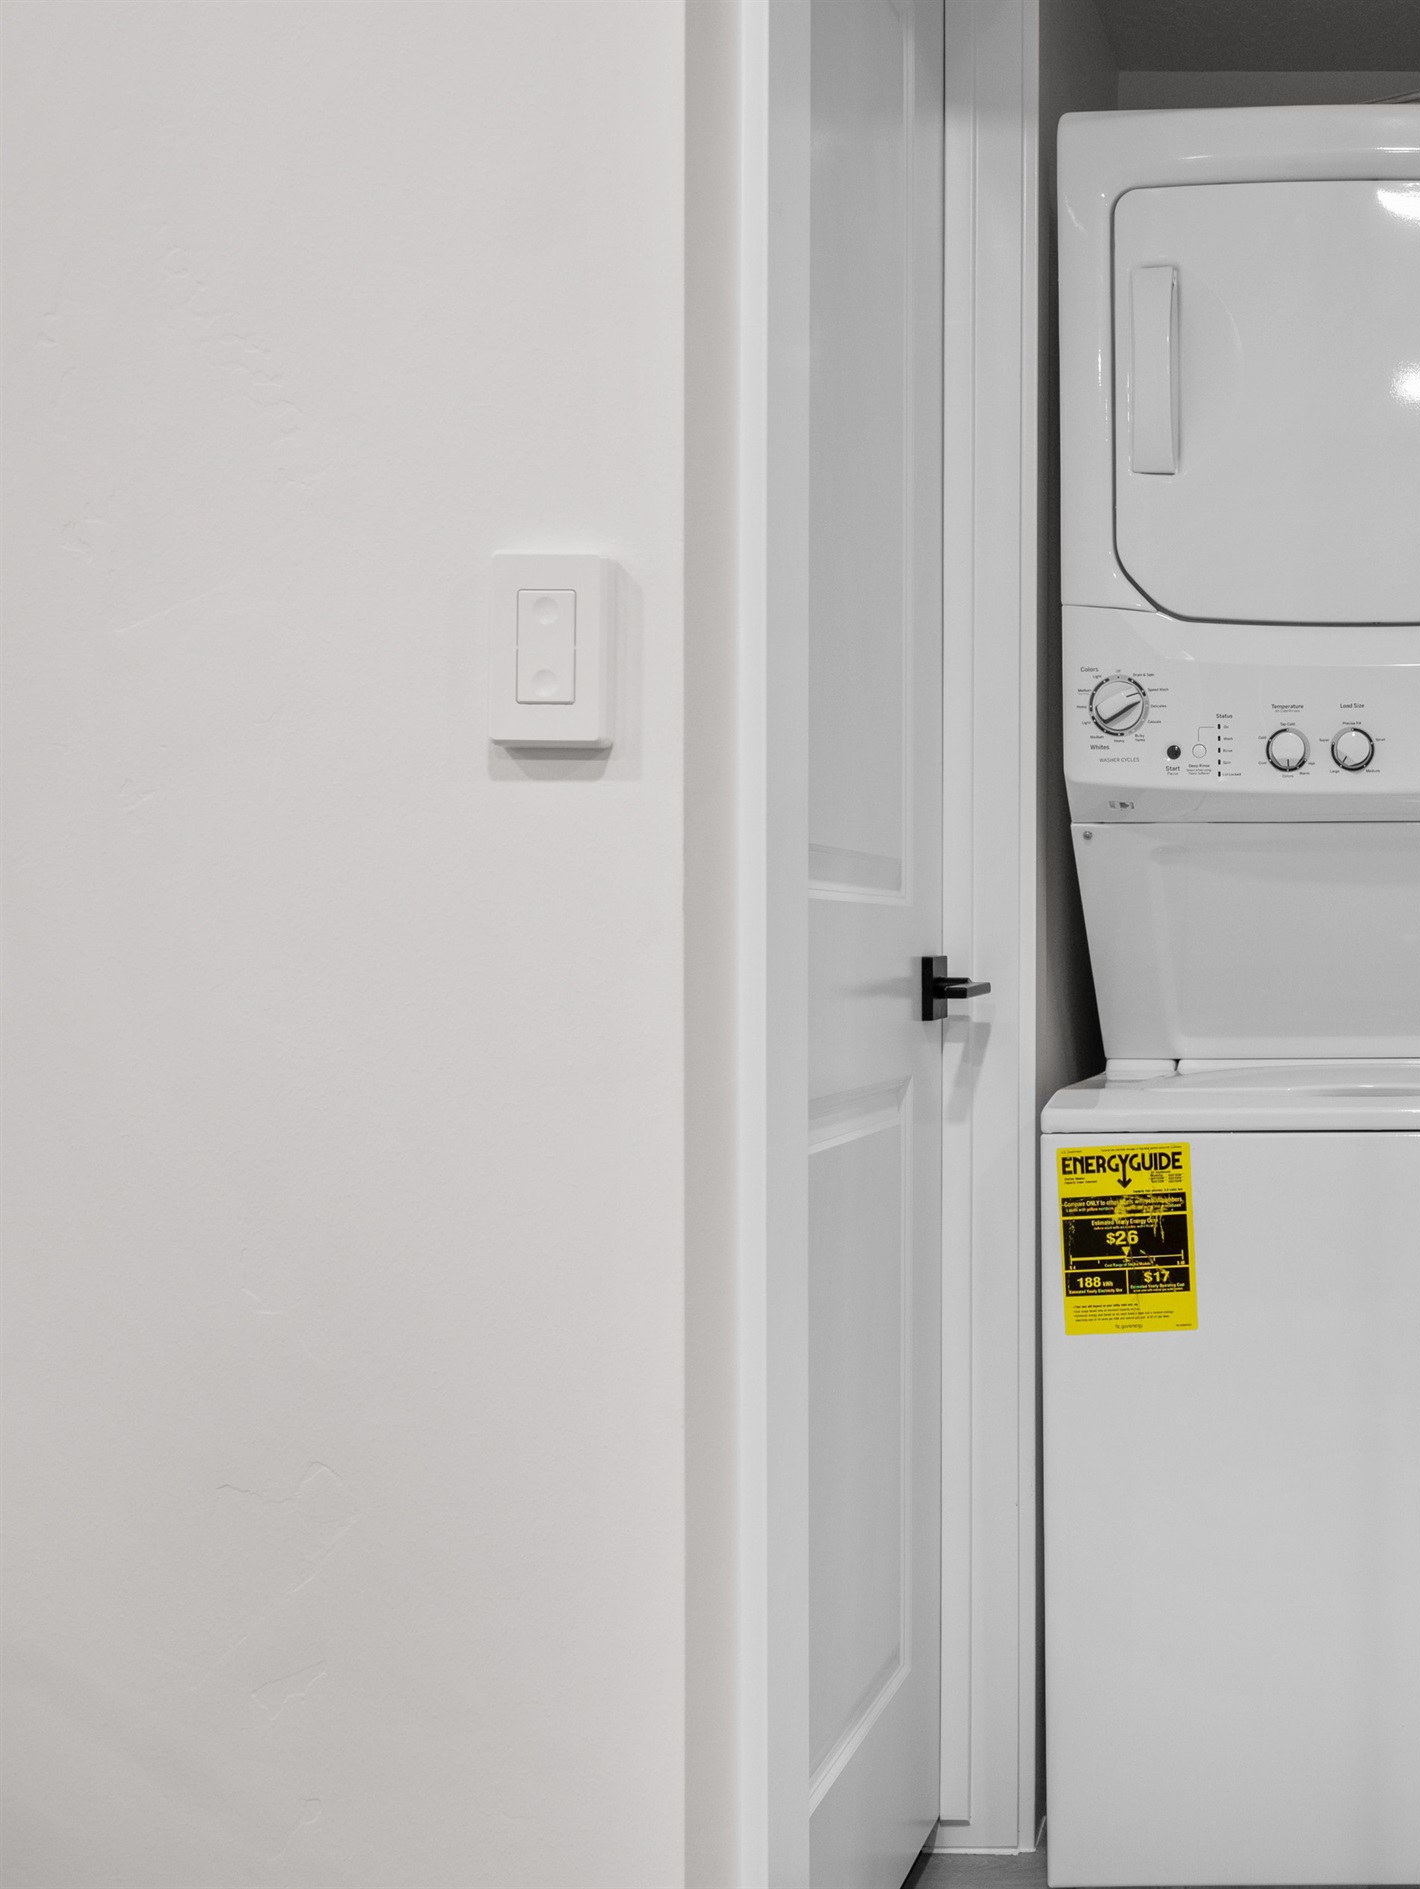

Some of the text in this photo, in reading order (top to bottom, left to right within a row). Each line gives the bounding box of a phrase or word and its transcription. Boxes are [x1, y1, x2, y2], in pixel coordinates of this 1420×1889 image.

[1061, 1151, 1183, 1176] ENERGYGUIDE
[1130, 1218, 1146, 1226] Energy
[1106, 1230, 1139, 1246] $26
[1077, 1276, 1101, 1288] 188
[1143, 1270, 1170, 1284] $17
